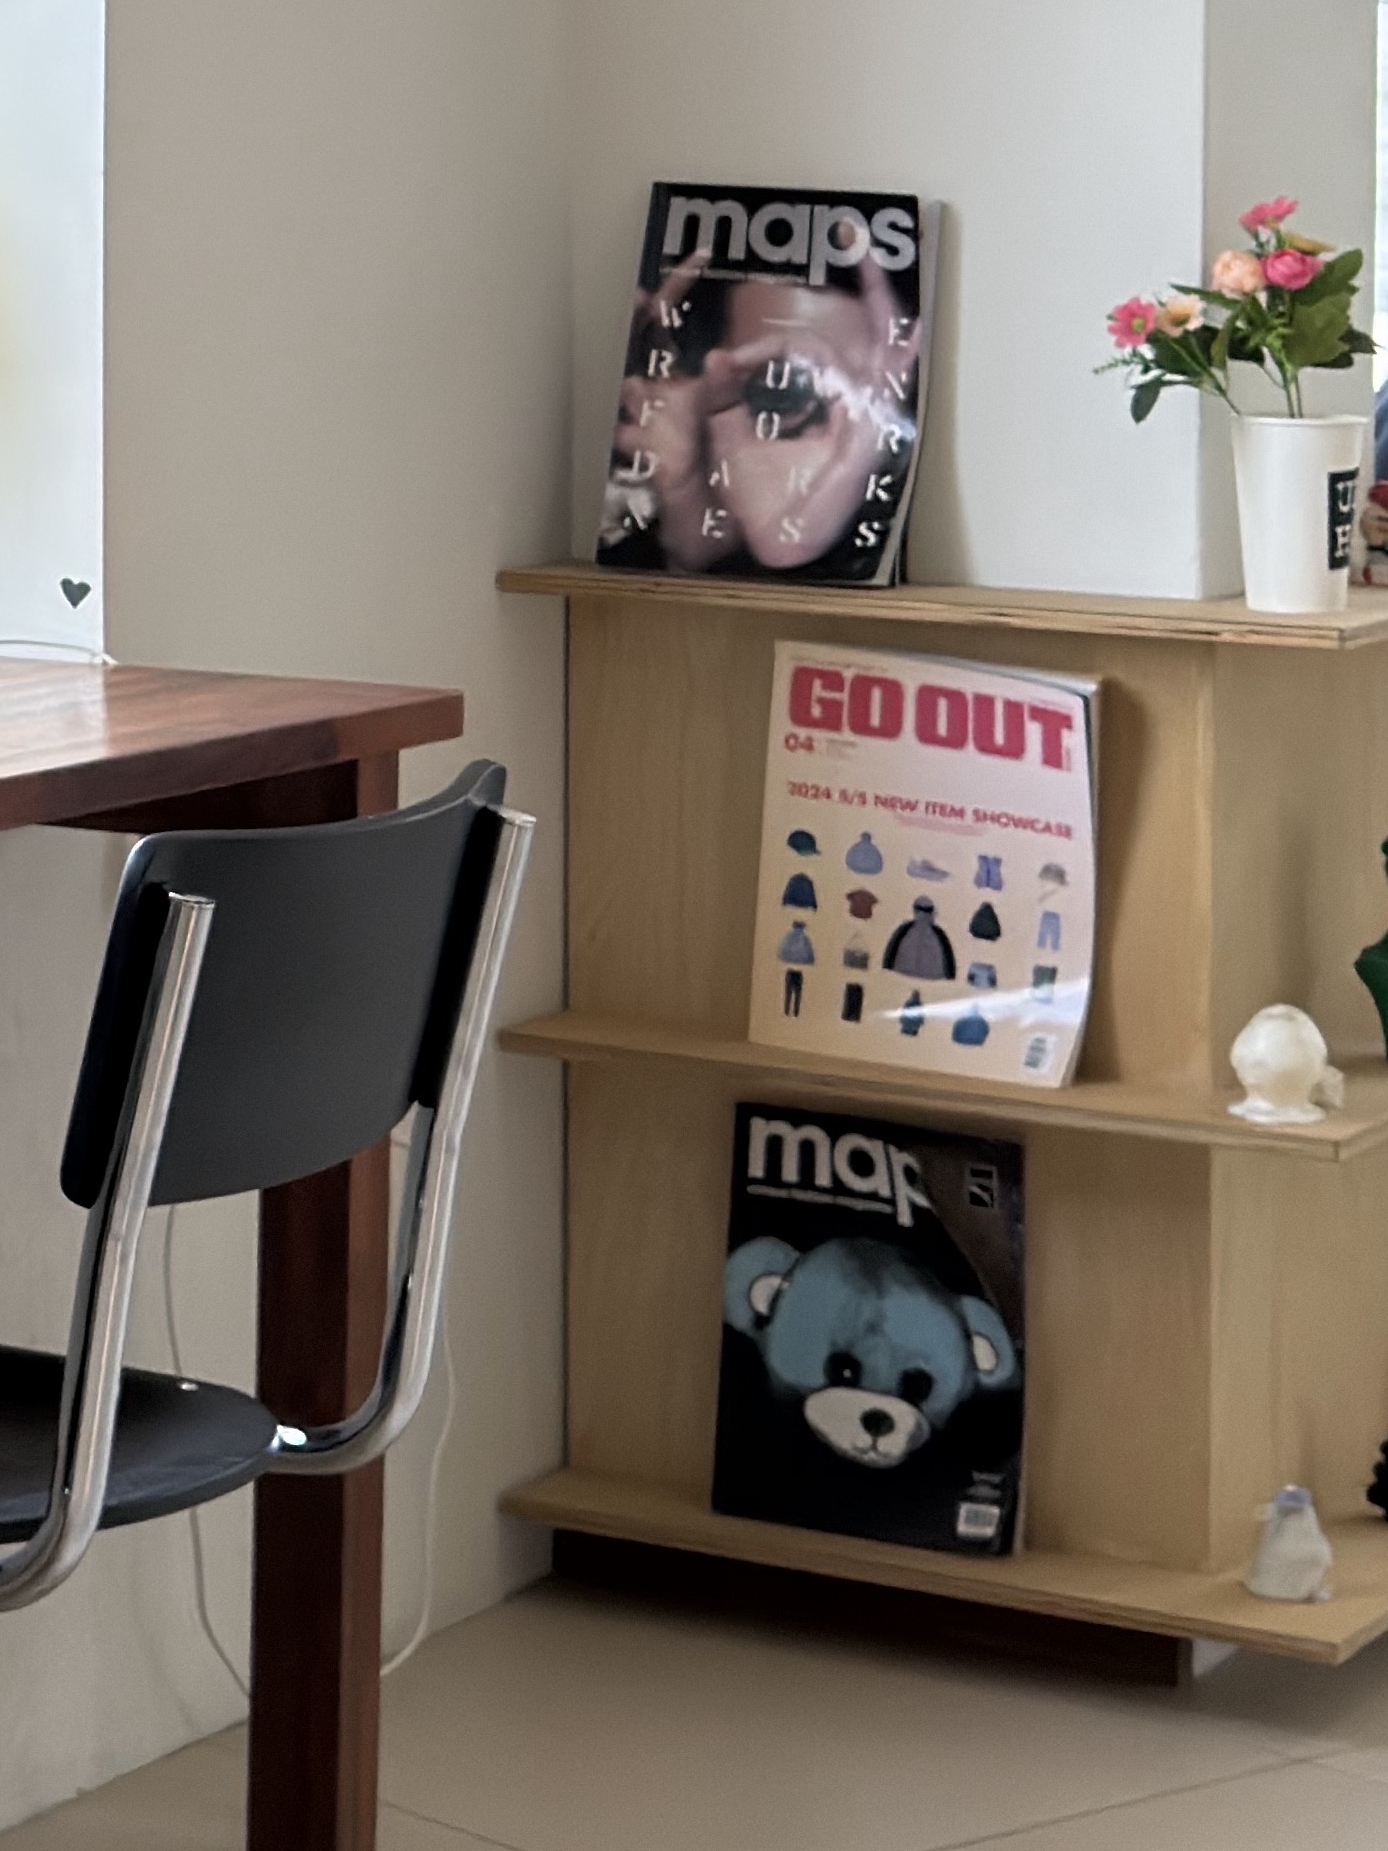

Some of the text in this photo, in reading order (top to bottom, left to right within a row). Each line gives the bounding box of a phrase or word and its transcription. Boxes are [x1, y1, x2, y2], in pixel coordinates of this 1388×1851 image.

[662, 196, 916, 286] maps
[789, 665, 1073, 771] GO OUT
[873, 794, 919, 812] NEW
[924, 800, 966, 821] ITEM
[972, 806, 1073, 839] SHOWCASE
